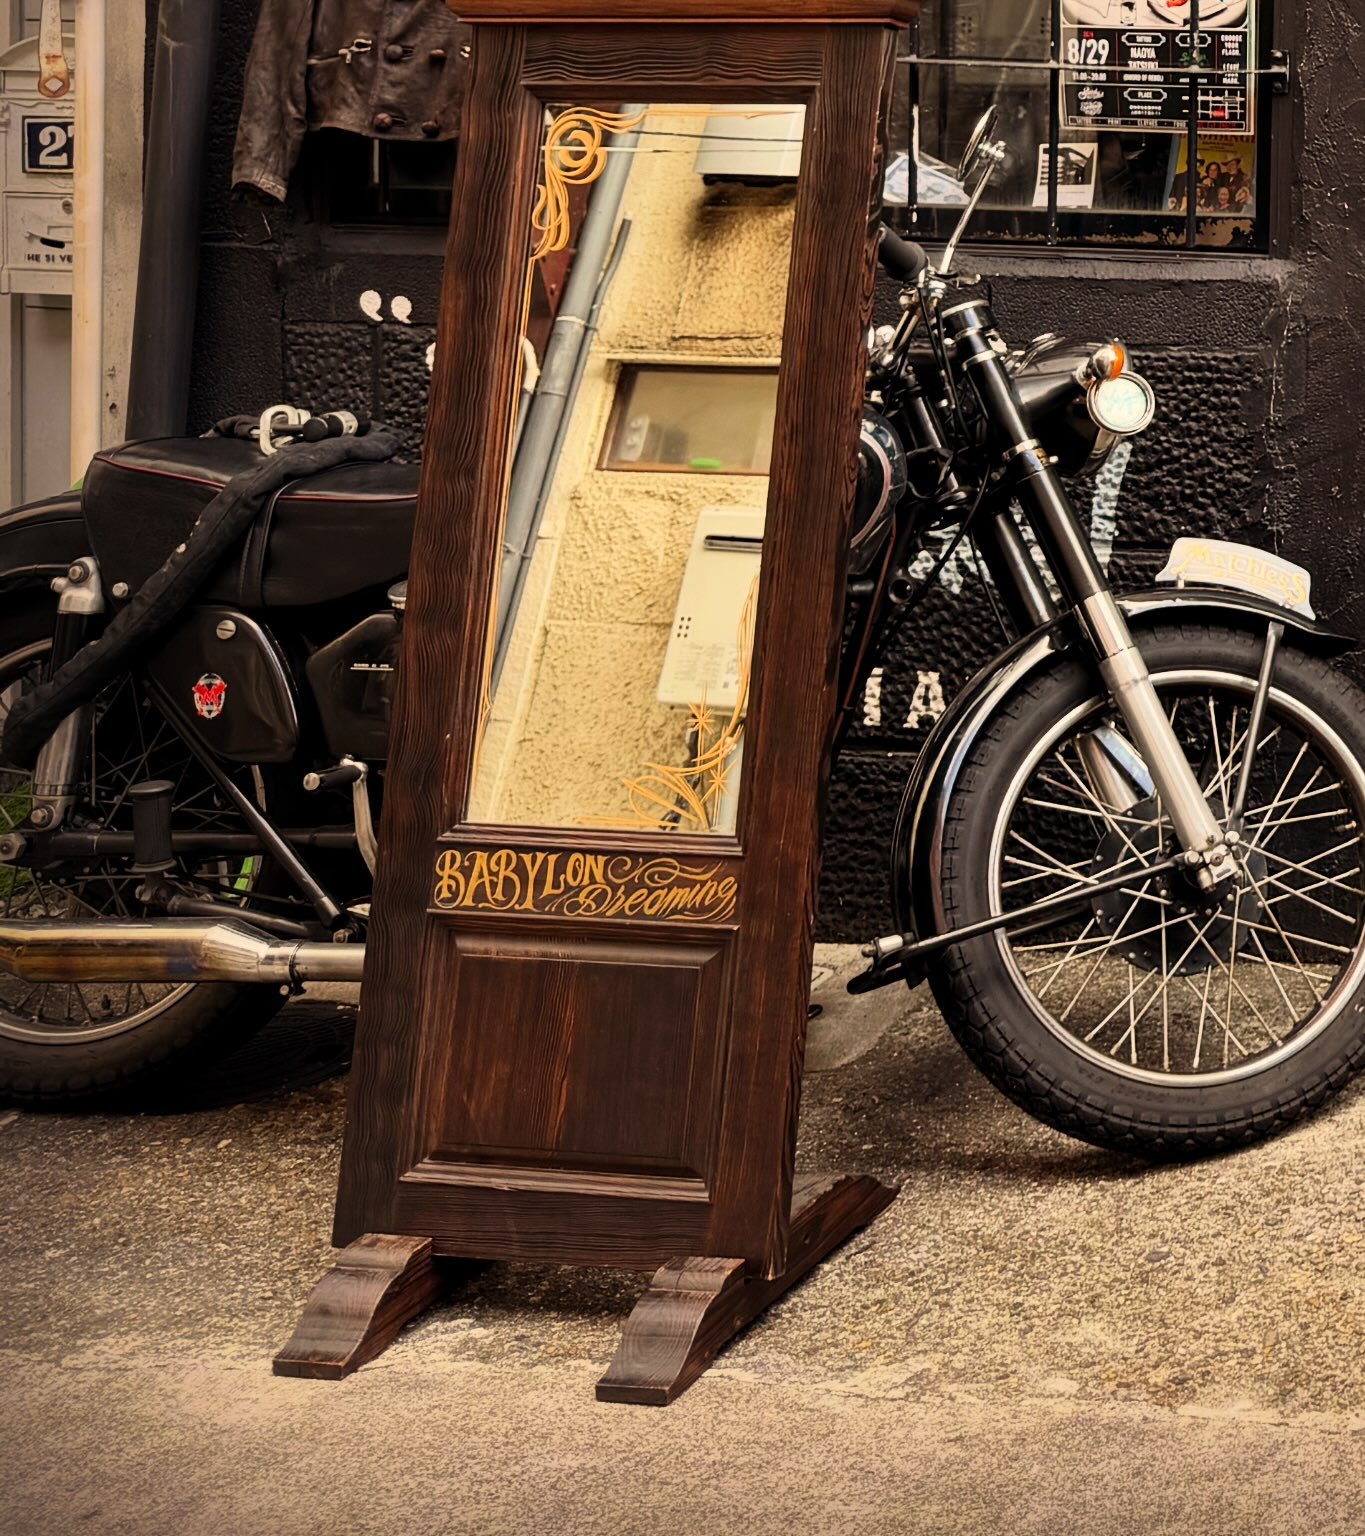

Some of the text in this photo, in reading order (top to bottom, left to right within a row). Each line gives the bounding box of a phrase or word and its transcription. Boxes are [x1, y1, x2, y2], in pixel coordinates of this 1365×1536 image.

[1068, 39, 1110, 65] 8/29
[39, 125, 75, 166] 2
[433, 848, 609, 913] BABYLON
[545, 874, 738, 922] Dreaming
